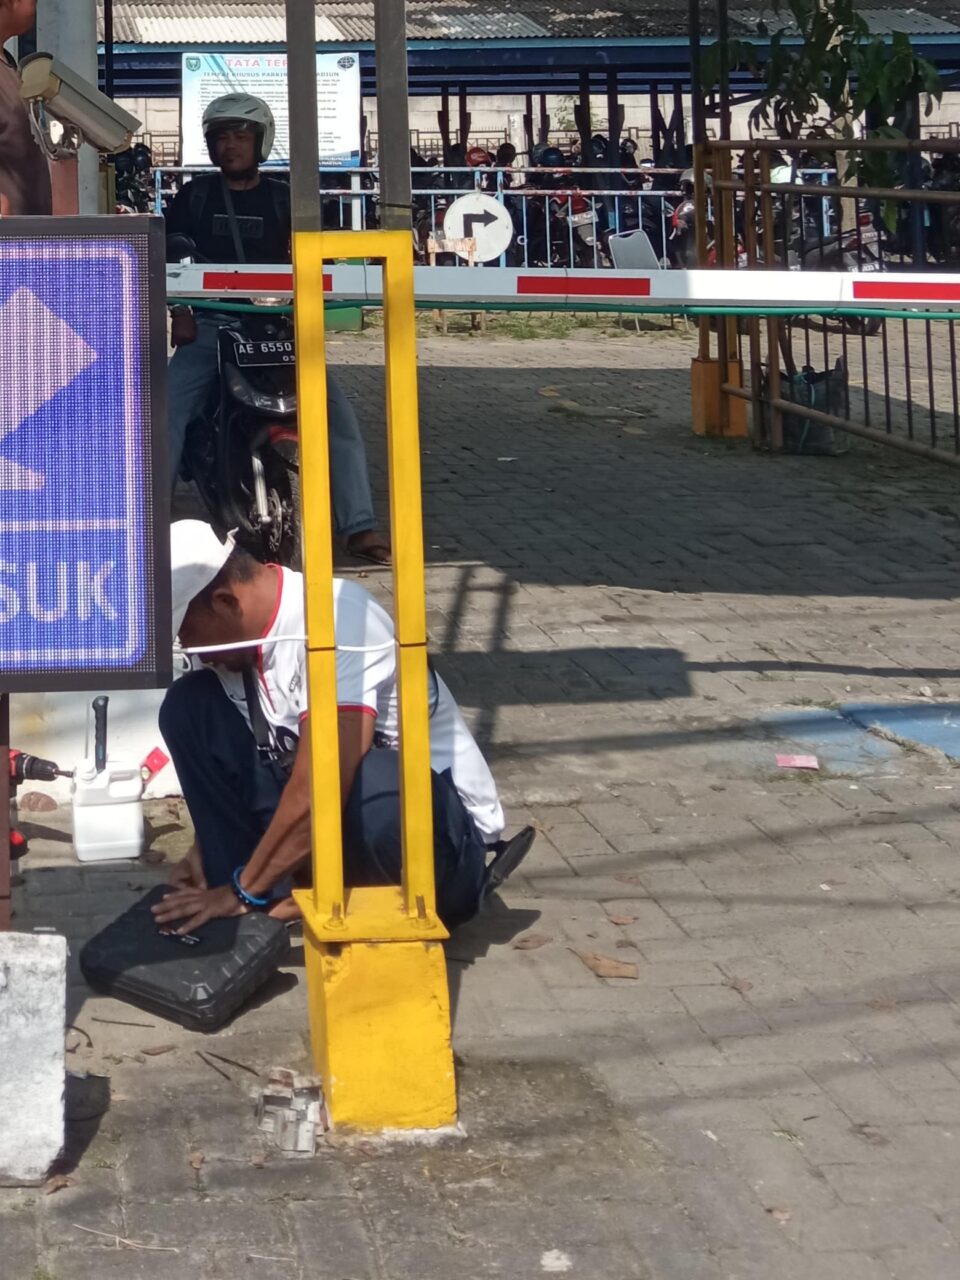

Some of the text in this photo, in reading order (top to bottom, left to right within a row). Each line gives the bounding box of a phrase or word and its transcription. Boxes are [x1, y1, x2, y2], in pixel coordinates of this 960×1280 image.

[227, 59, 260, 68] TATA
[239, 342, 292, 354] AE 6550
